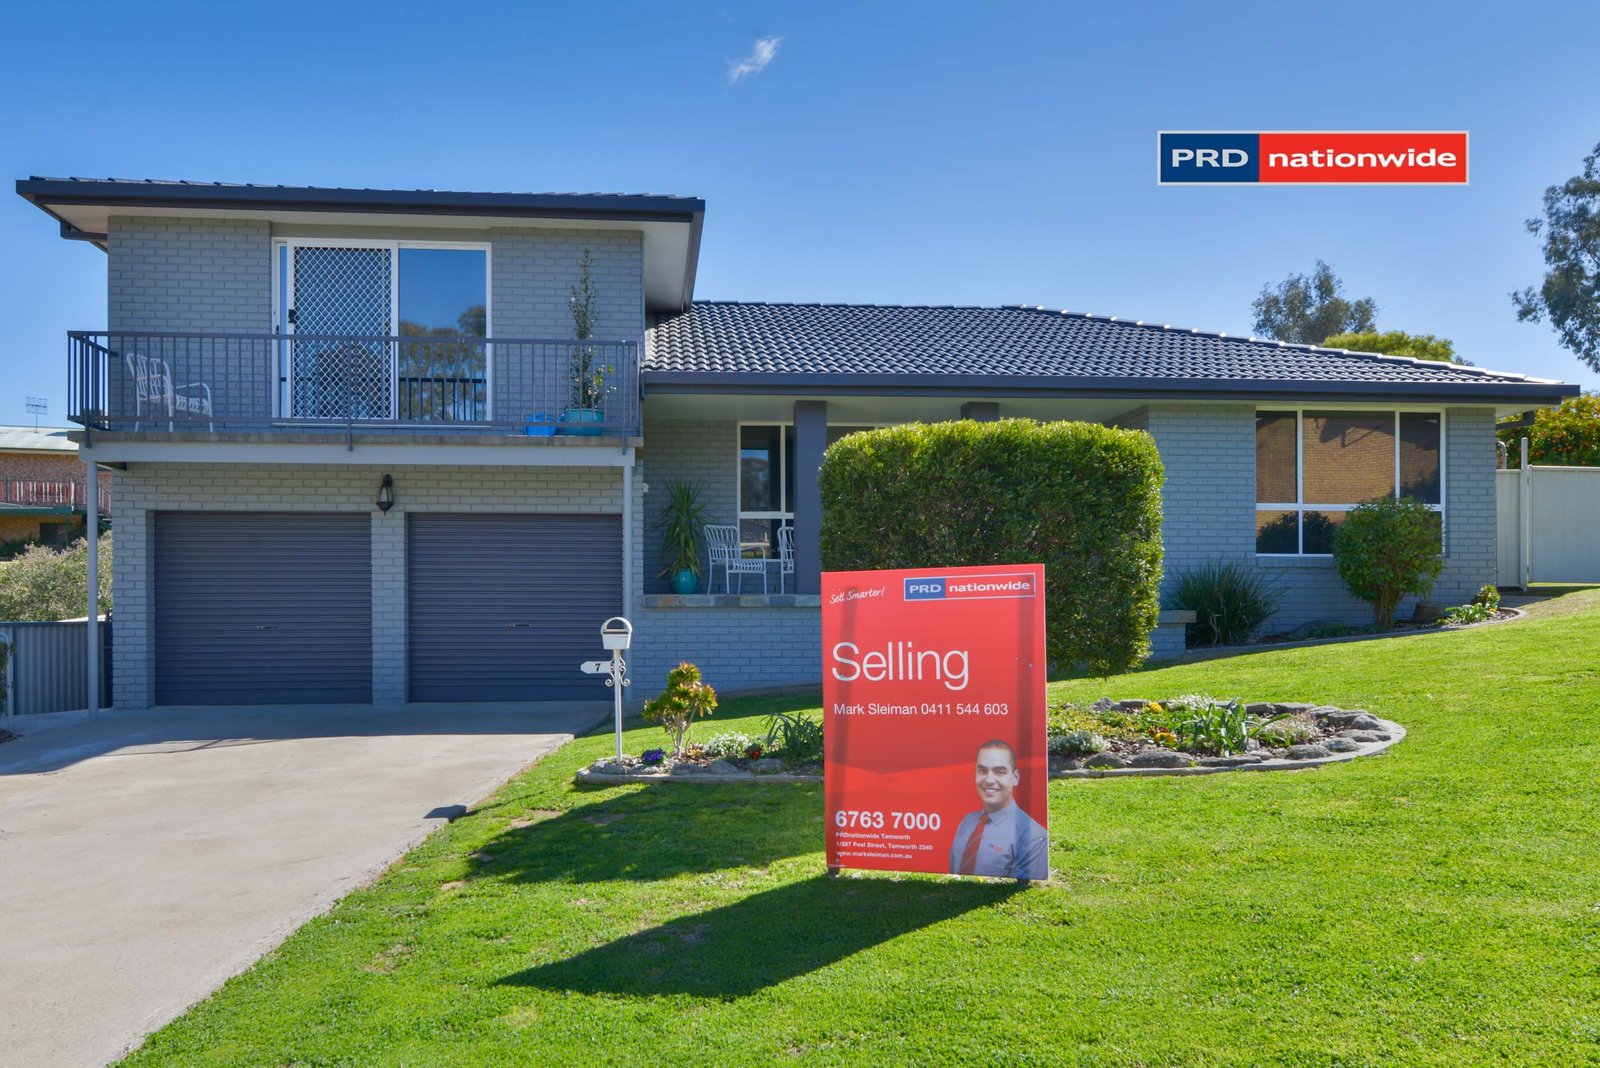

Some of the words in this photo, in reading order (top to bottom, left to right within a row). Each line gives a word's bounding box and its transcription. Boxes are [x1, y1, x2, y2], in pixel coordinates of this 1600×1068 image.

[847, 586, 886, 600] Smarter!
[909, 584, 942, 594] PRD
[949, 580, 1031, 593] nationwide
[595, 663, 601, 672] 7
[831, 641, 969, 691] Selling
[833, 703, 864, 715] Mark
[868, 703, 917, 715] Sleiman
[920, 703, 951, 715] 0411
[956, 703, 980, 715] 544
[984, 703, 1009, 715] 603
[835, 810, 884, 829] 6763
[891, 811, 941, 831] 7000
